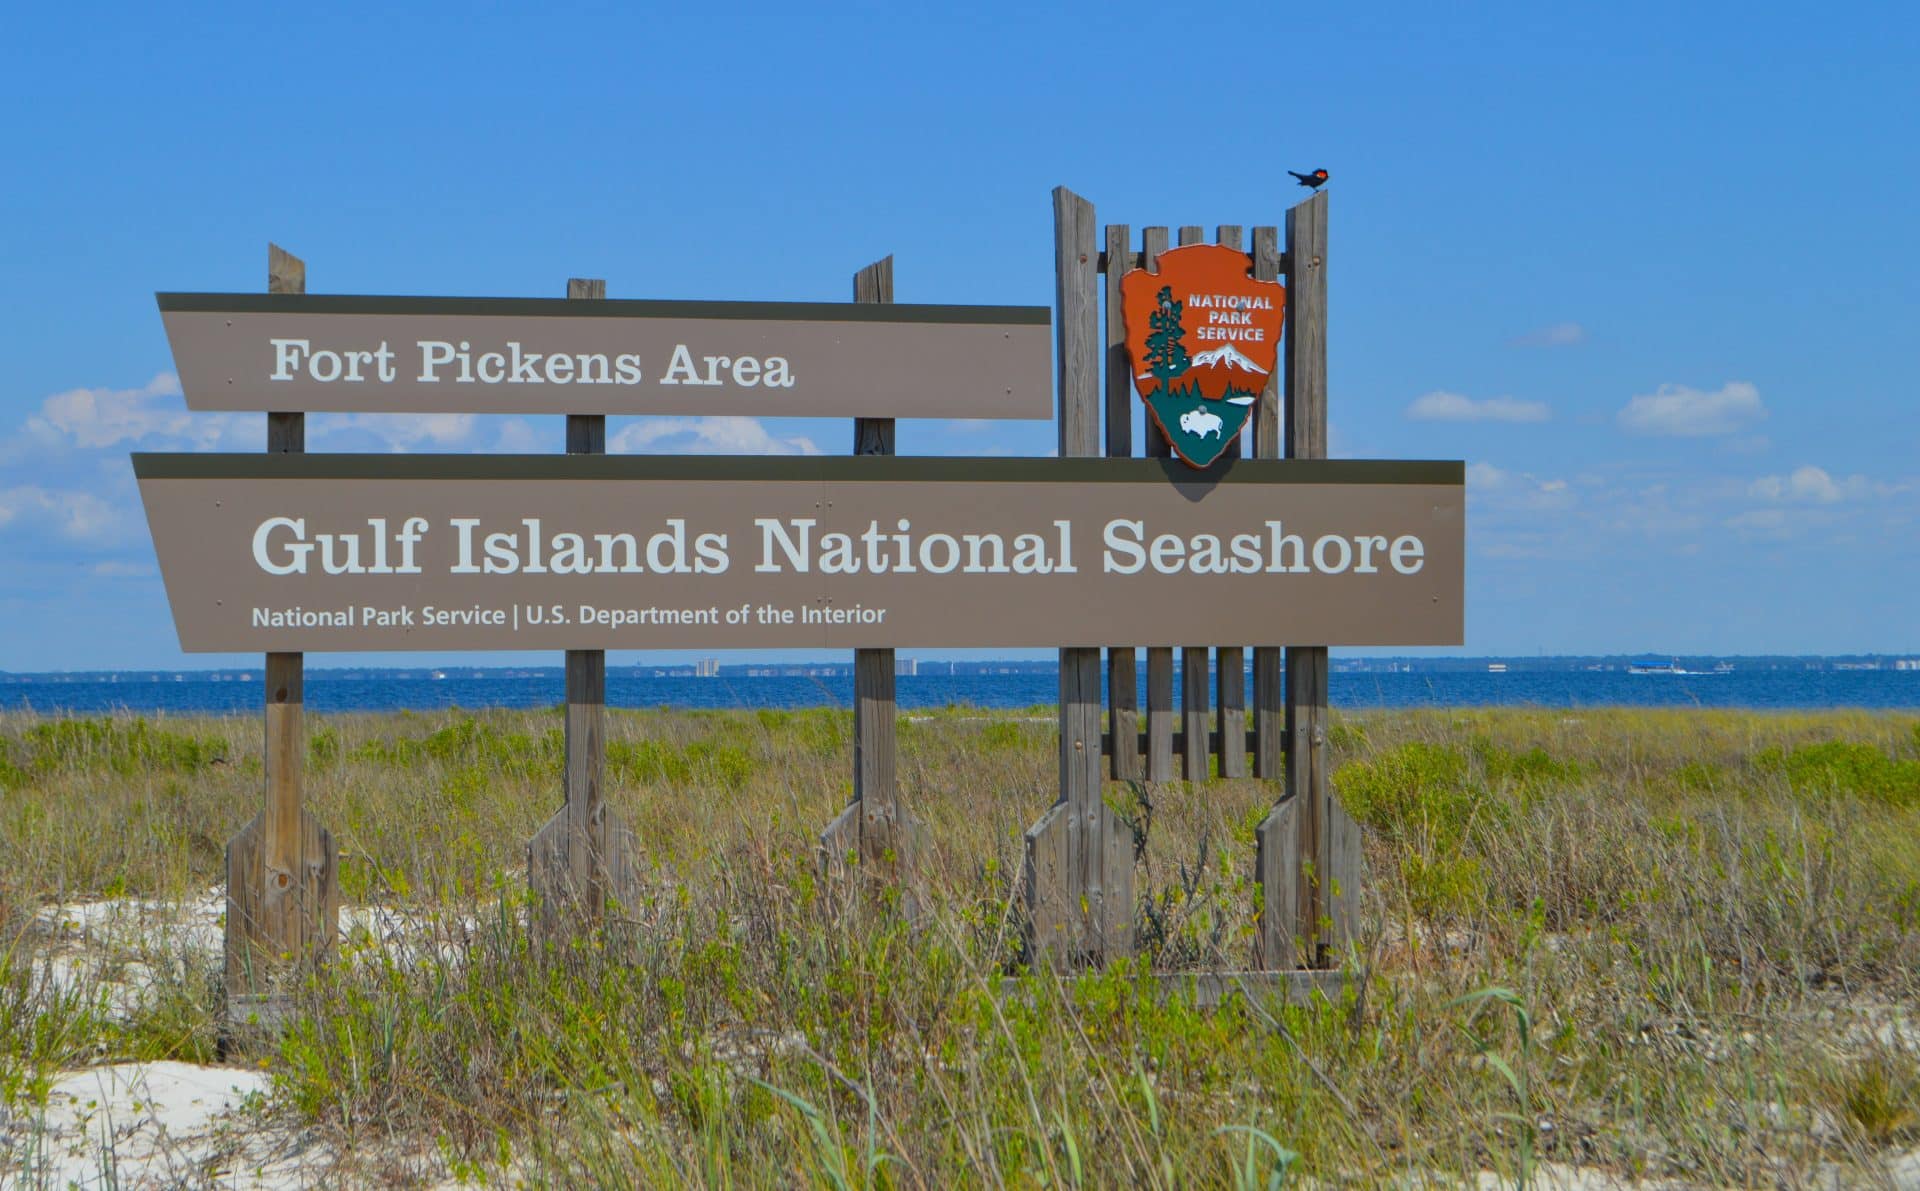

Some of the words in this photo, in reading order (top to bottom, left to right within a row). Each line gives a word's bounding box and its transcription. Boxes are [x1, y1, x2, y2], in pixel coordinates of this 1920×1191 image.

[1189, 294, 1273, 309] NATIONAL
[1209, 311, 1252, 324] PARK
[1197, 327, 1264, 341] SERVICE
[270, 339, 396, 383] Fort
[416, 340, 642, 386] Pickens
[659, 344, 795, 388] Area
[252, 517, 430, 575] Gulf
[450, 518, 730, 575] Islands
[755, 519, 1077, 575] National
[1103, 519, 1424, 575] Seashore
[252, 606, 354, 626] National
[362, 607, 415, 626] Park
[422, 605, 506, 626] Service
[526, 605, 571, 625] U.S.
[580, 605, 719, 629] Department
[725, 604, 751, 624] of
[755, 605, 794, 624] the
[802, 605, 886, 624] Interior
